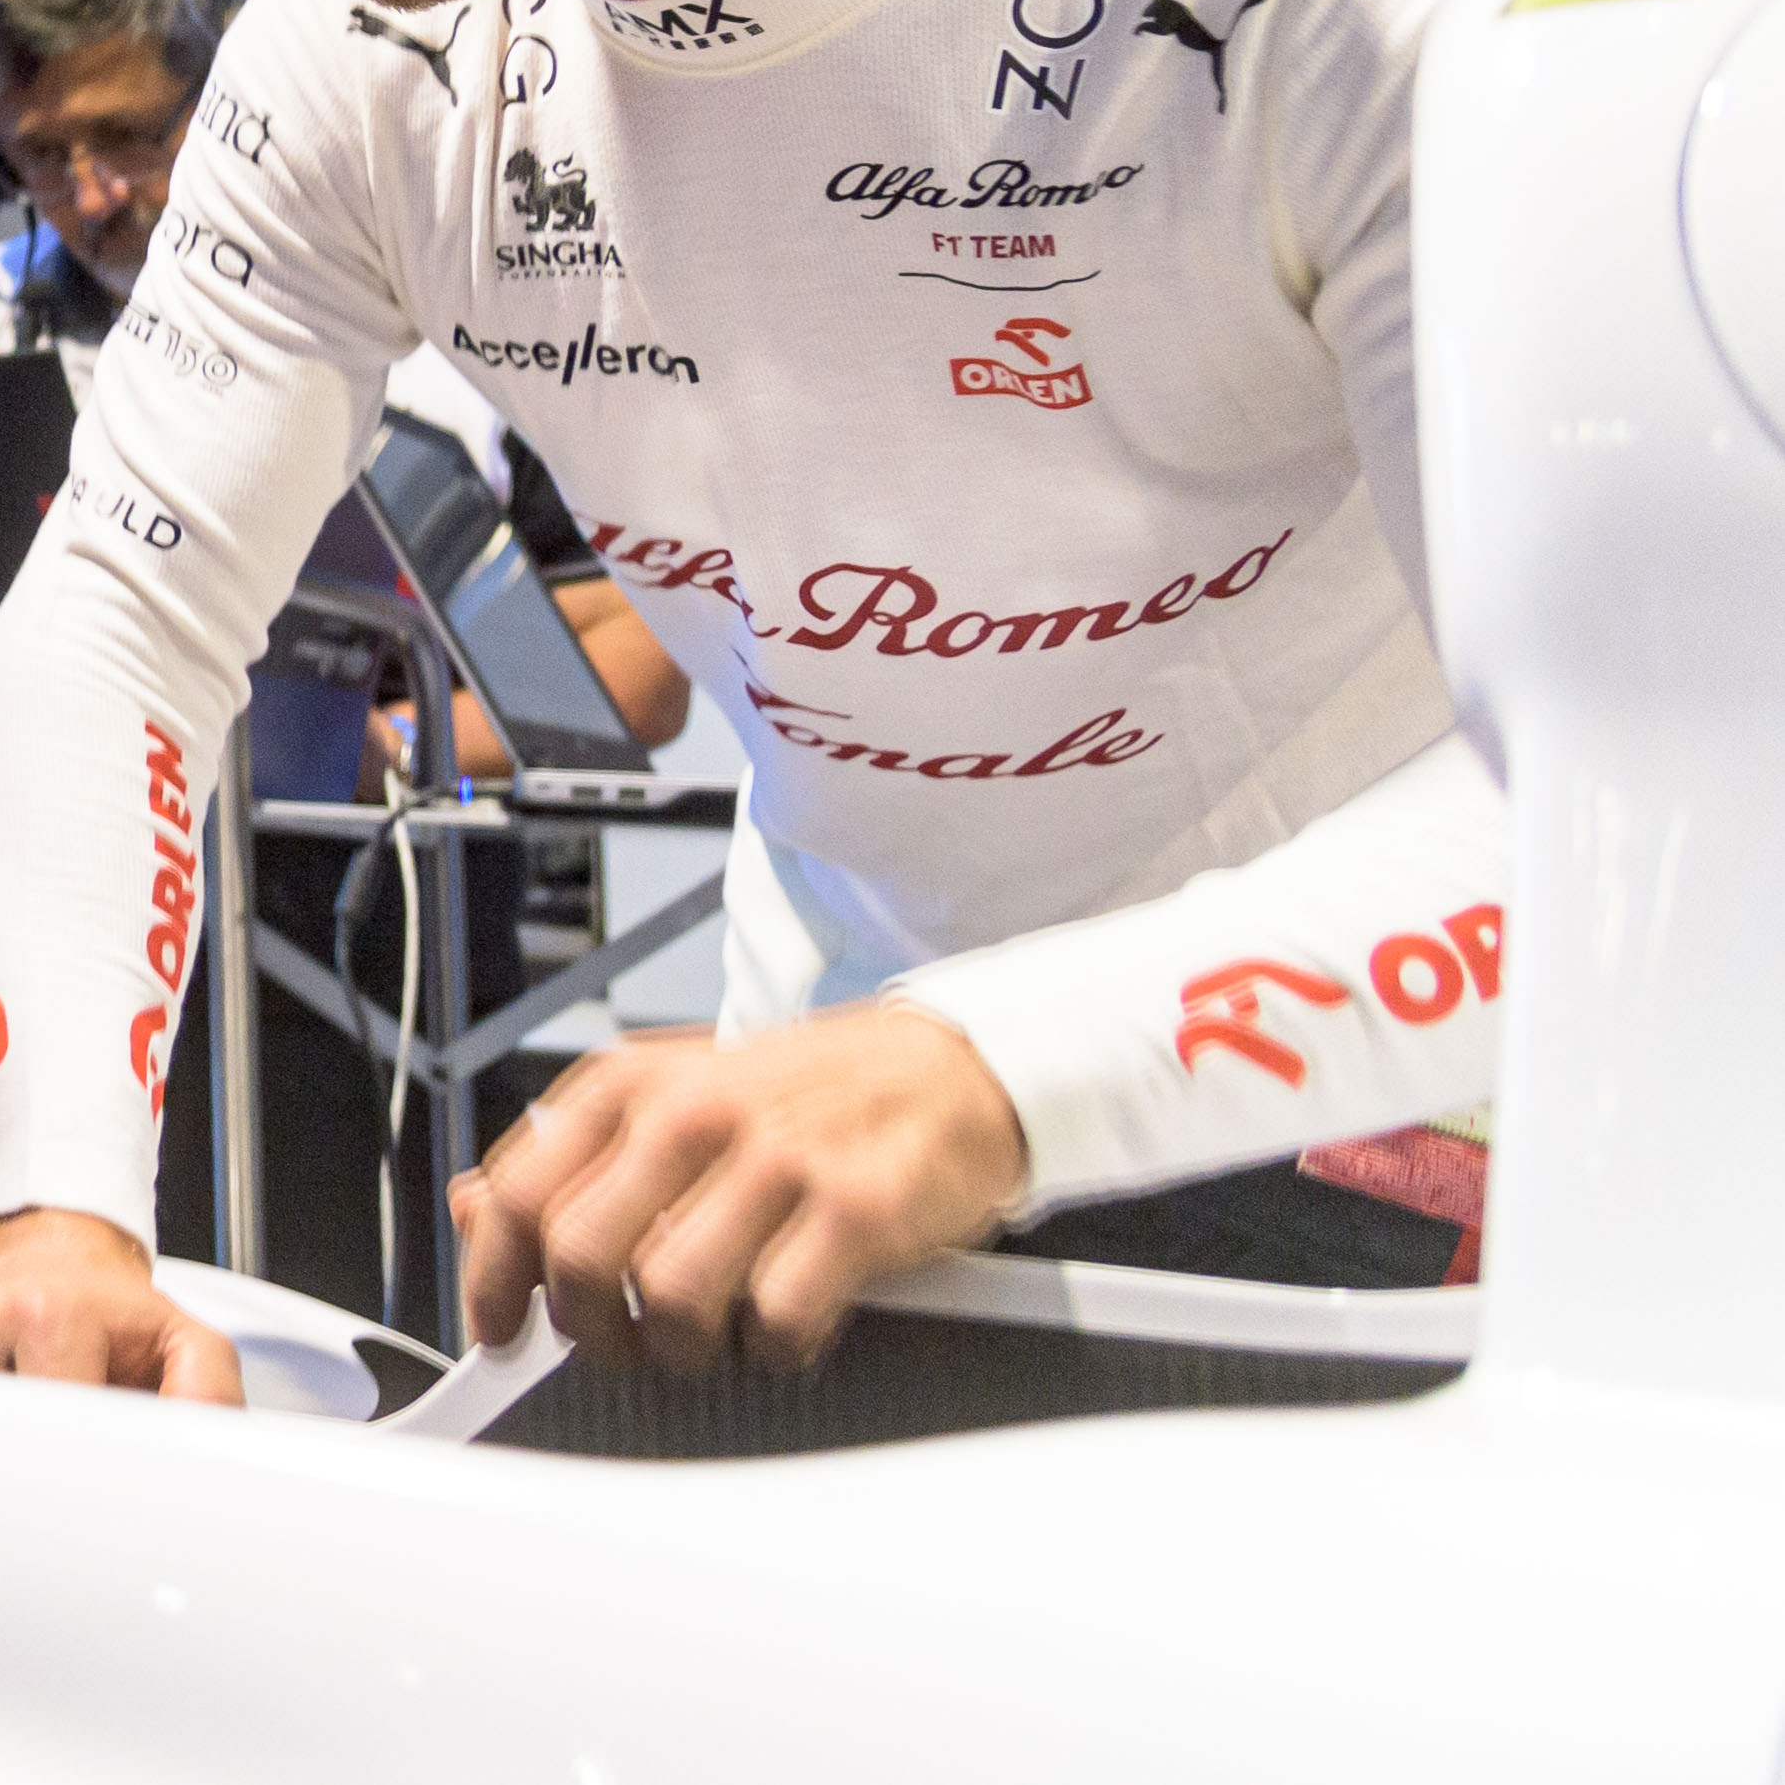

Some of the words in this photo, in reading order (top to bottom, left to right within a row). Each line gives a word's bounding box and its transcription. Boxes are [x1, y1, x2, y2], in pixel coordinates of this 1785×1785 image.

[825, 162, 958, 220] Alfa
[495, 241, 623, 271] SINGHA
[931, 231, 963, 256] F1
[969, 234, 1057, 259] TEAM
[959, 362, 1084, 405] ORLEN
[786, 526, 1294, 658] Romeo
[144, 718, 197, 995] ORLEN
